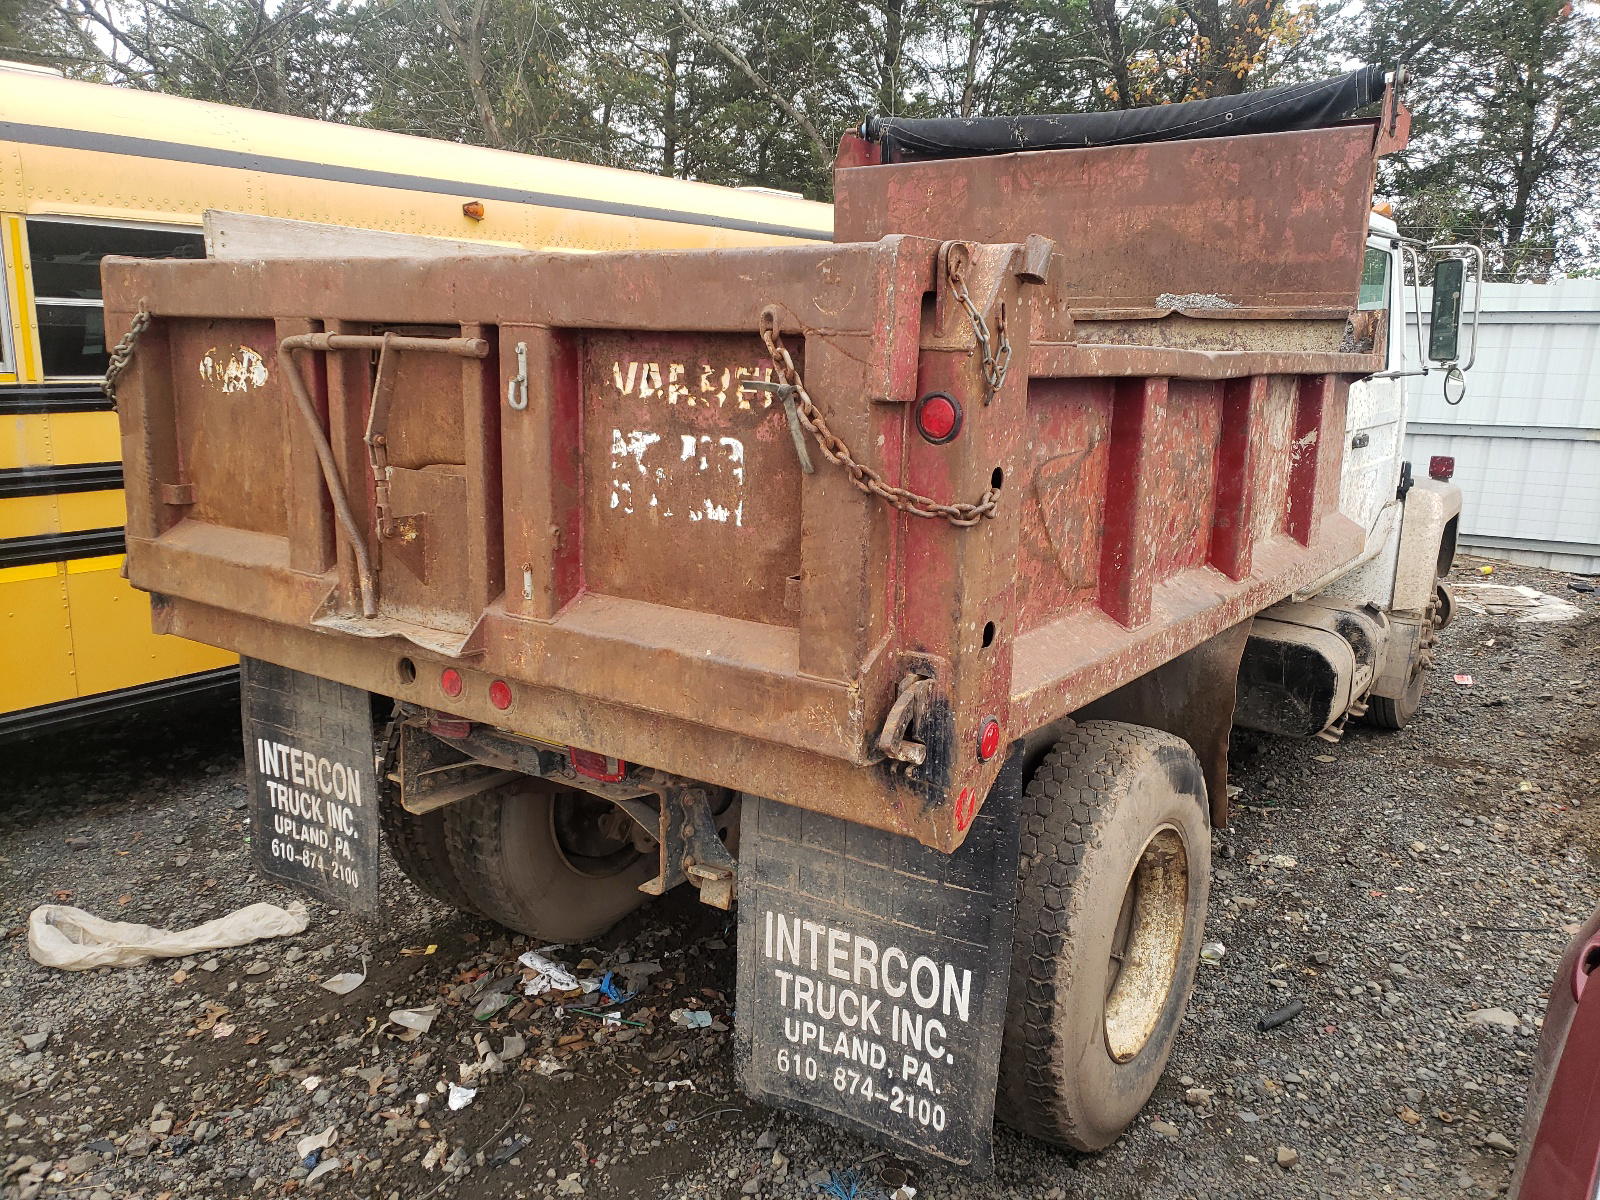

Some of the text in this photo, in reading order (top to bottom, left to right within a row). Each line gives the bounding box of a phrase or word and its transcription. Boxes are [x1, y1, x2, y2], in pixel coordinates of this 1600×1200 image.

[257, 738, 362, 807] INTERCON
[266, 780, 359, 839] TRUCK INC.
[335, 836, 355, 862] PA.
[765, 911, 972, 1023] INTERCON
[775, 969, 954, 1065] TRUCK INC.
[784, 1017, 941, 1095] UPLAND, PA.
